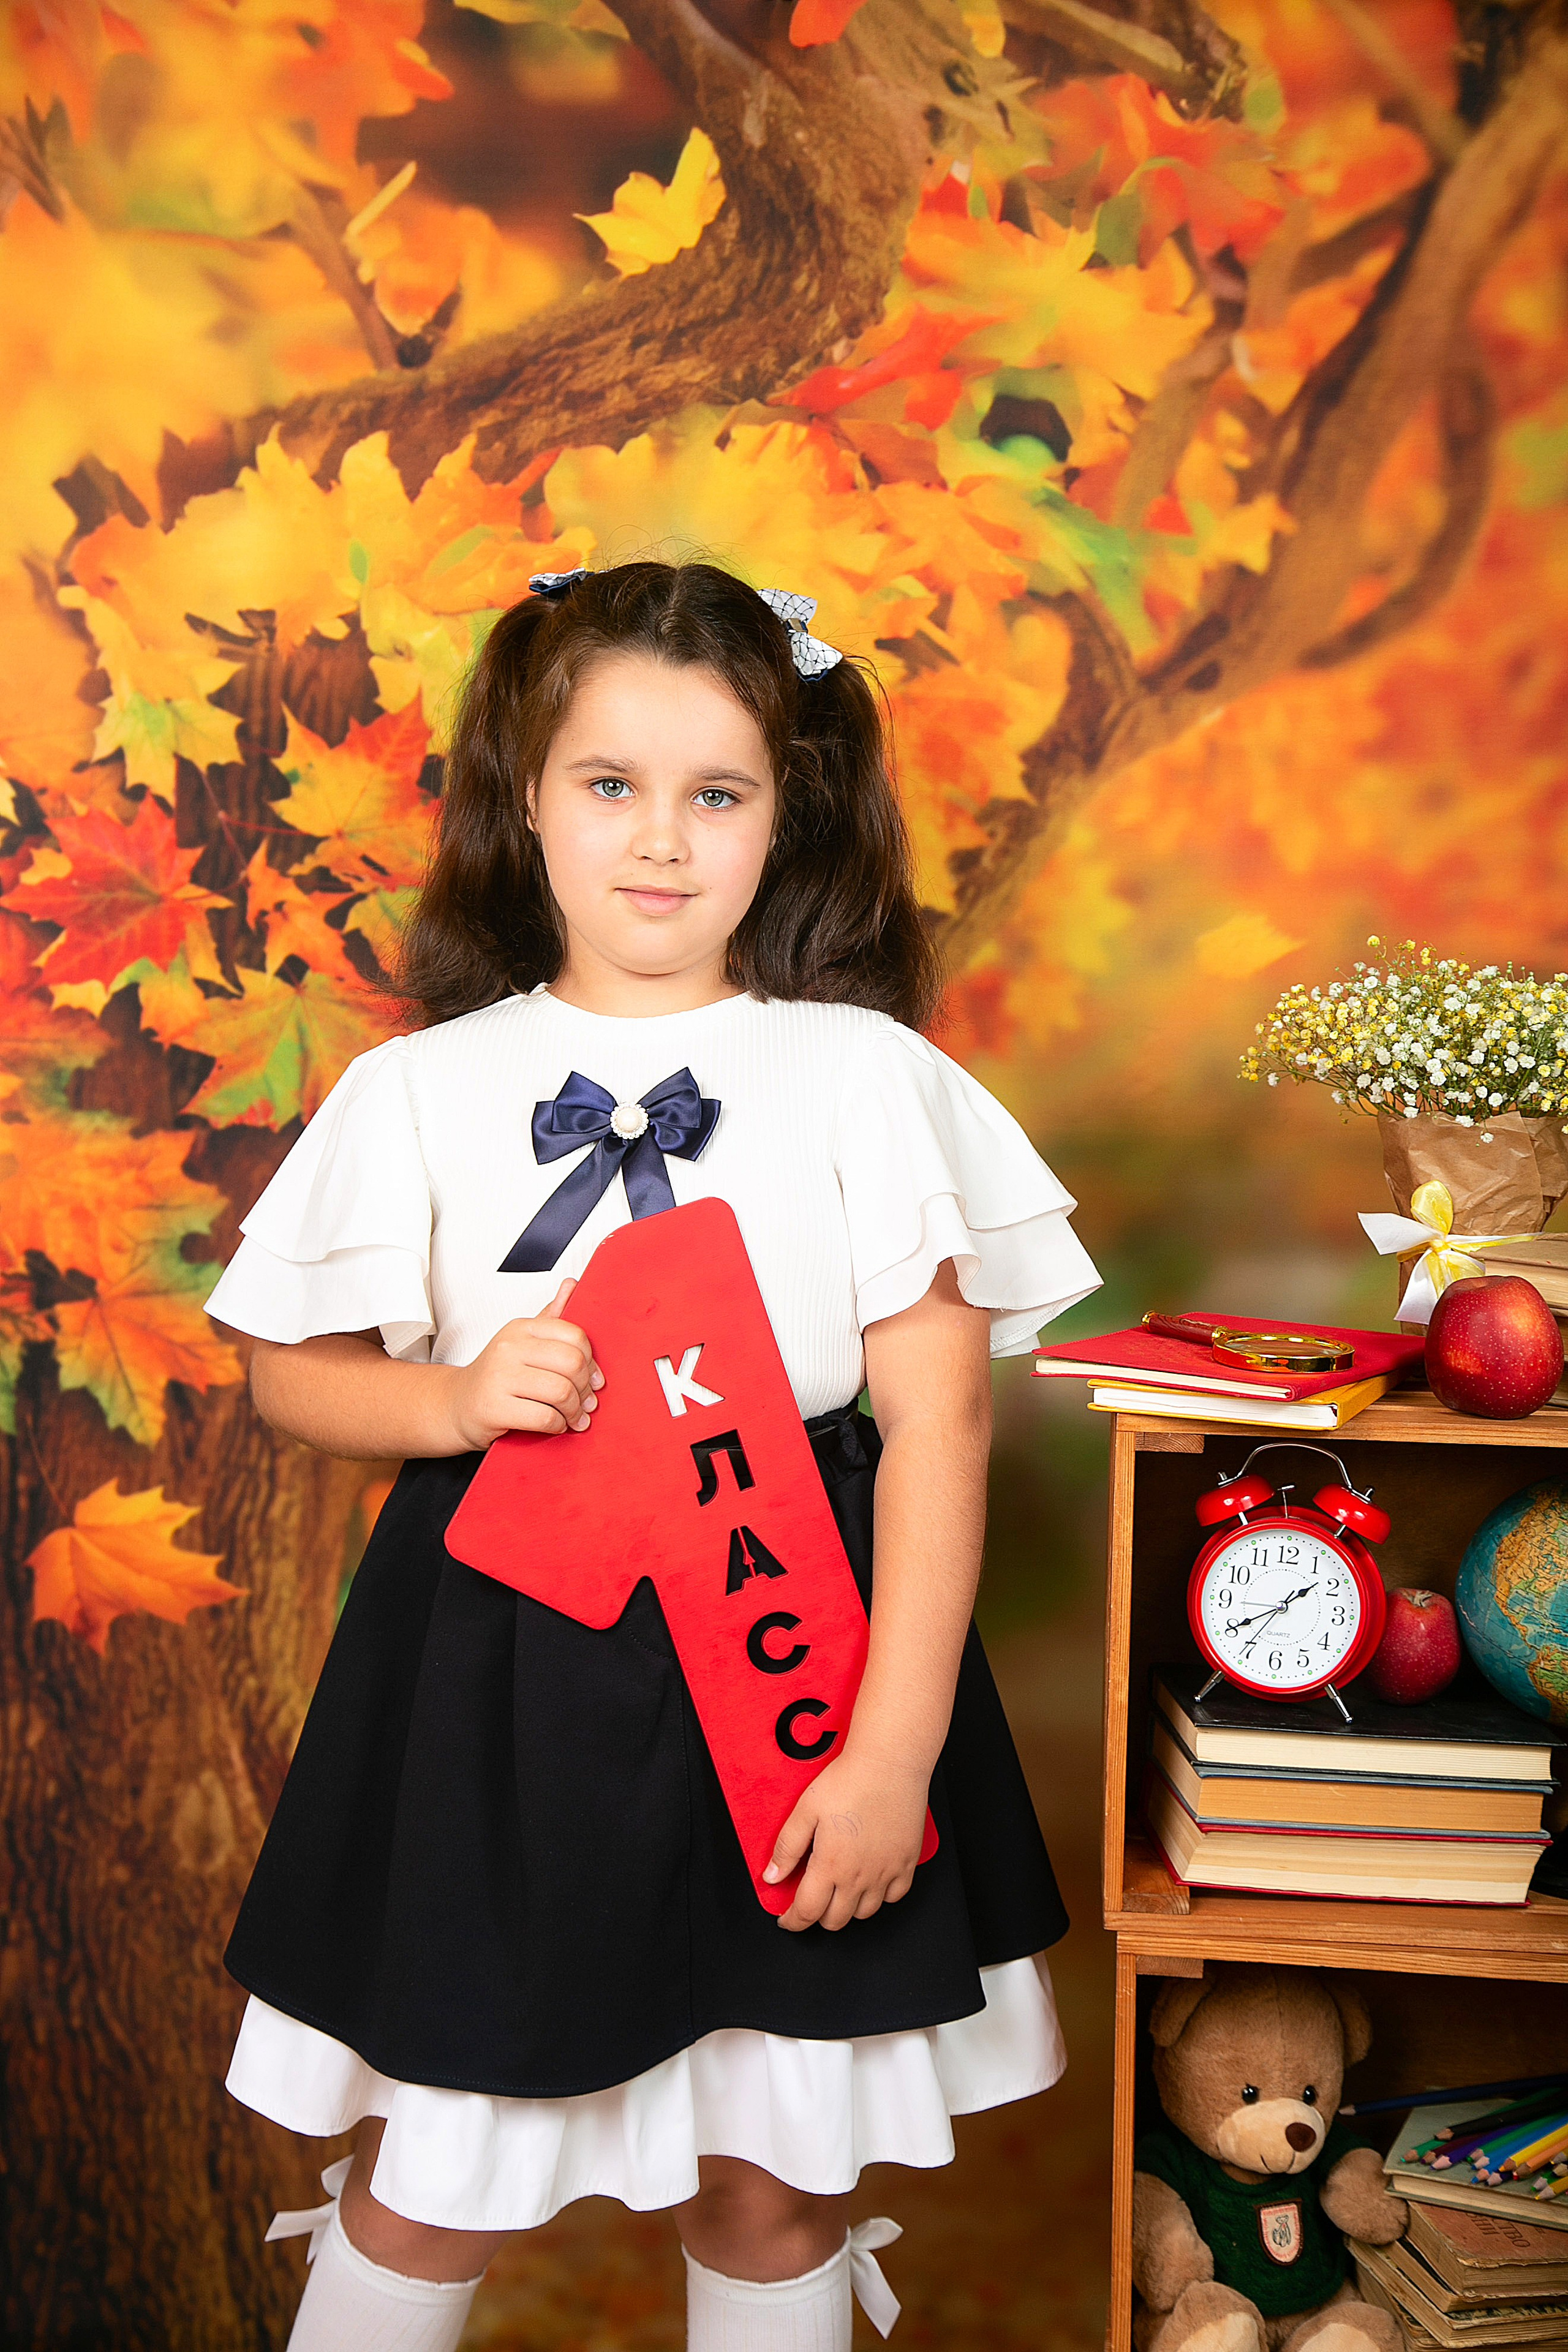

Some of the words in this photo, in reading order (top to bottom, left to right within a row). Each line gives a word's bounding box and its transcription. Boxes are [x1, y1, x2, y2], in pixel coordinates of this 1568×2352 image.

[654, 1343, 839, 1762] КЛАСС
[1251, 1548, 1268, 1567] 11
[1276, 1545, 1299, 1565] 12
[1227, 1565, 1250, 1585] 10
[1310, 1556, 1319, 1574] 1
[1326, 1578, 1340, 1597] 2
[1218, 1589, 1232, 1609] 9
[1332, 1605, 1345, 1626] 3
[1224, 1618, 1239, 1638] 8
[1245, 1641, 1257, 1659] 7
[1317, 1632, 1330, 1651] 4
[1268, 1650, 1283, 1671] 6
[1297, 1648, 1310, 1668] 5
